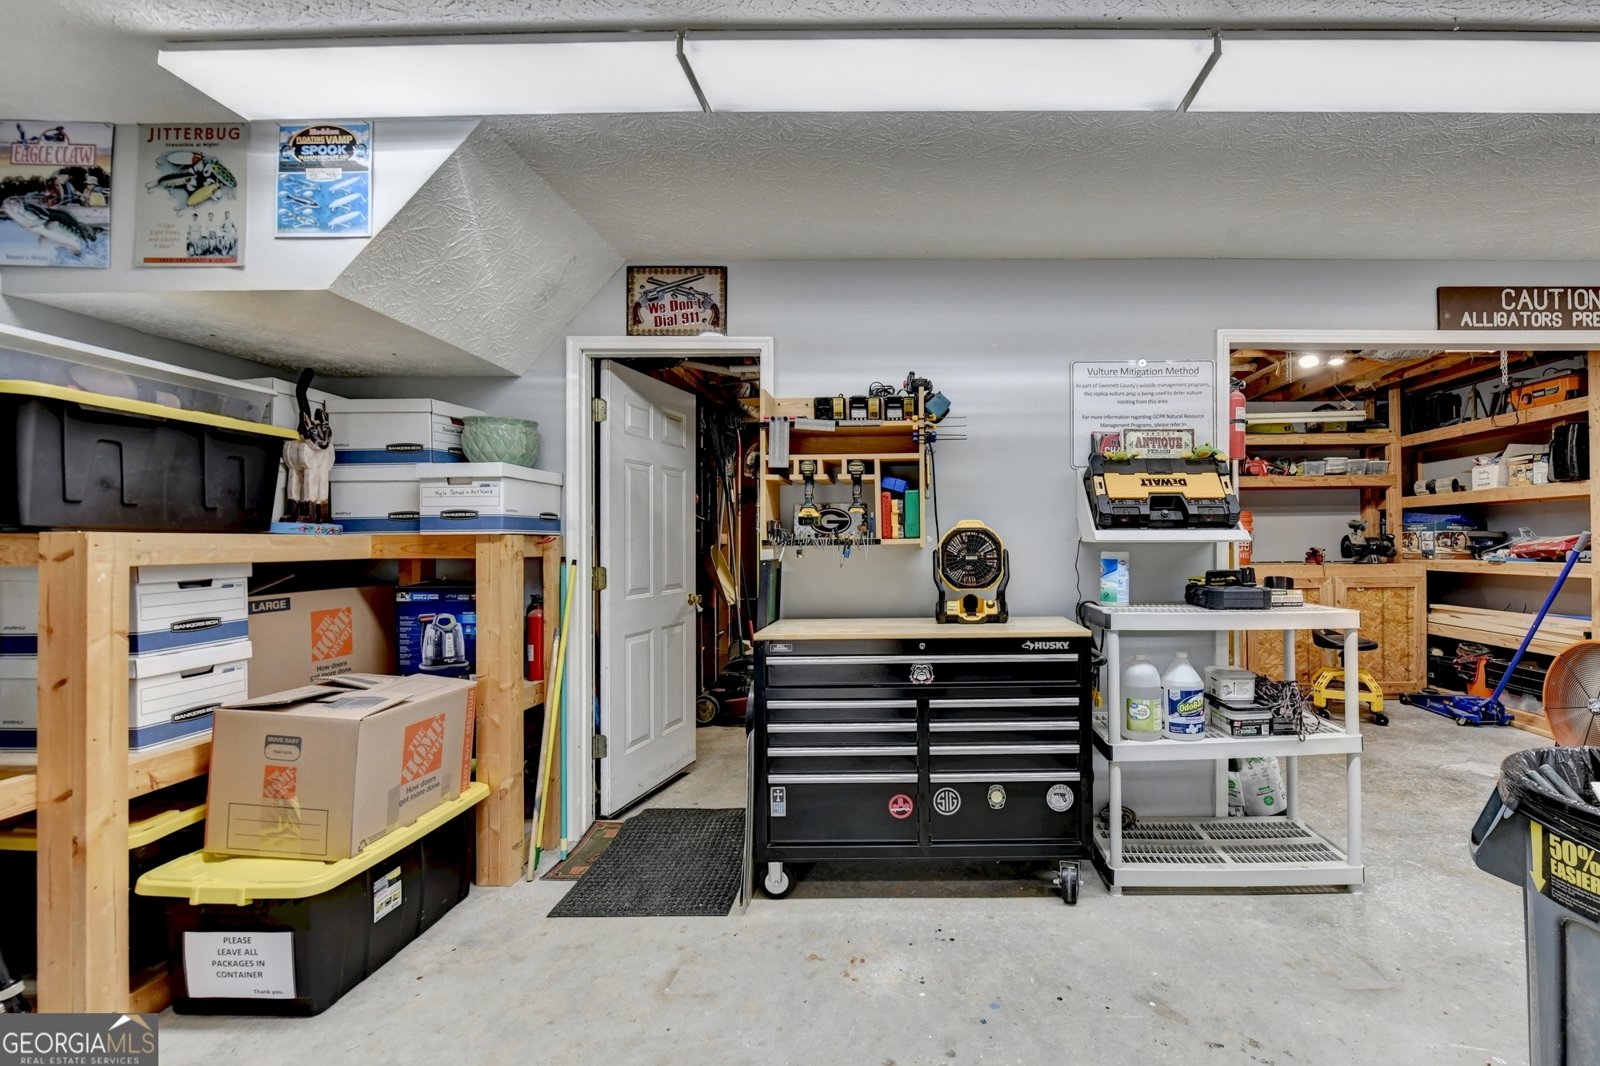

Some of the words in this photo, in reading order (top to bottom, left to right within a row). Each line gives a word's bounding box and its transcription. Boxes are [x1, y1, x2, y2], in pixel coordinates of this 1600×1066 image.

[147, 127, 240, 142] JITTERBUG
[325, 135, 353, 144] VAMP
[14, 145, 53, 163] EAGLE
[55, 146, 93, 164] CLAW
[301, 145, 347, 155] SPOOK
[1501, 288, 1600, 311] CAUTION
[648, 302, 666, 314] We
[654, 314, 678, 328] Dial
[682, 311, 700, 325] 911
[1460, 311, 1563, 327] ALLIGATORS
[1087, 367, 1118, 376] Vulture
[1120, 367, 1163, 378] Mitigation
[1165, 366, 1200, 375] Method
[1135, 436, 1183, 449] ANTIQUE
[252, 600, 287, 612] LARGE
[173, 622, 205, 630] BANKERS
[312, 607, 352, 660] HOME
[1034, 641, 1070, 650] HUSKY
[316, 664, 330, 672] How
[331, 661, 348, 669] doers
[466, 689, 475, 735] MEDIUM
[401, 716, 445, 780] HOME
[406, 783, 420, 794] How
[420, 775, 437, 787] doers
[398, 794, 410, 806] get
[409, 789, 426, 801] more
[1549, 832, 1600, 877] 50%
[1550, 857, 1600, 896] EASIER
[217, 948, 242, 956] LEAVE
[244, 948, 259, 956] ALL
